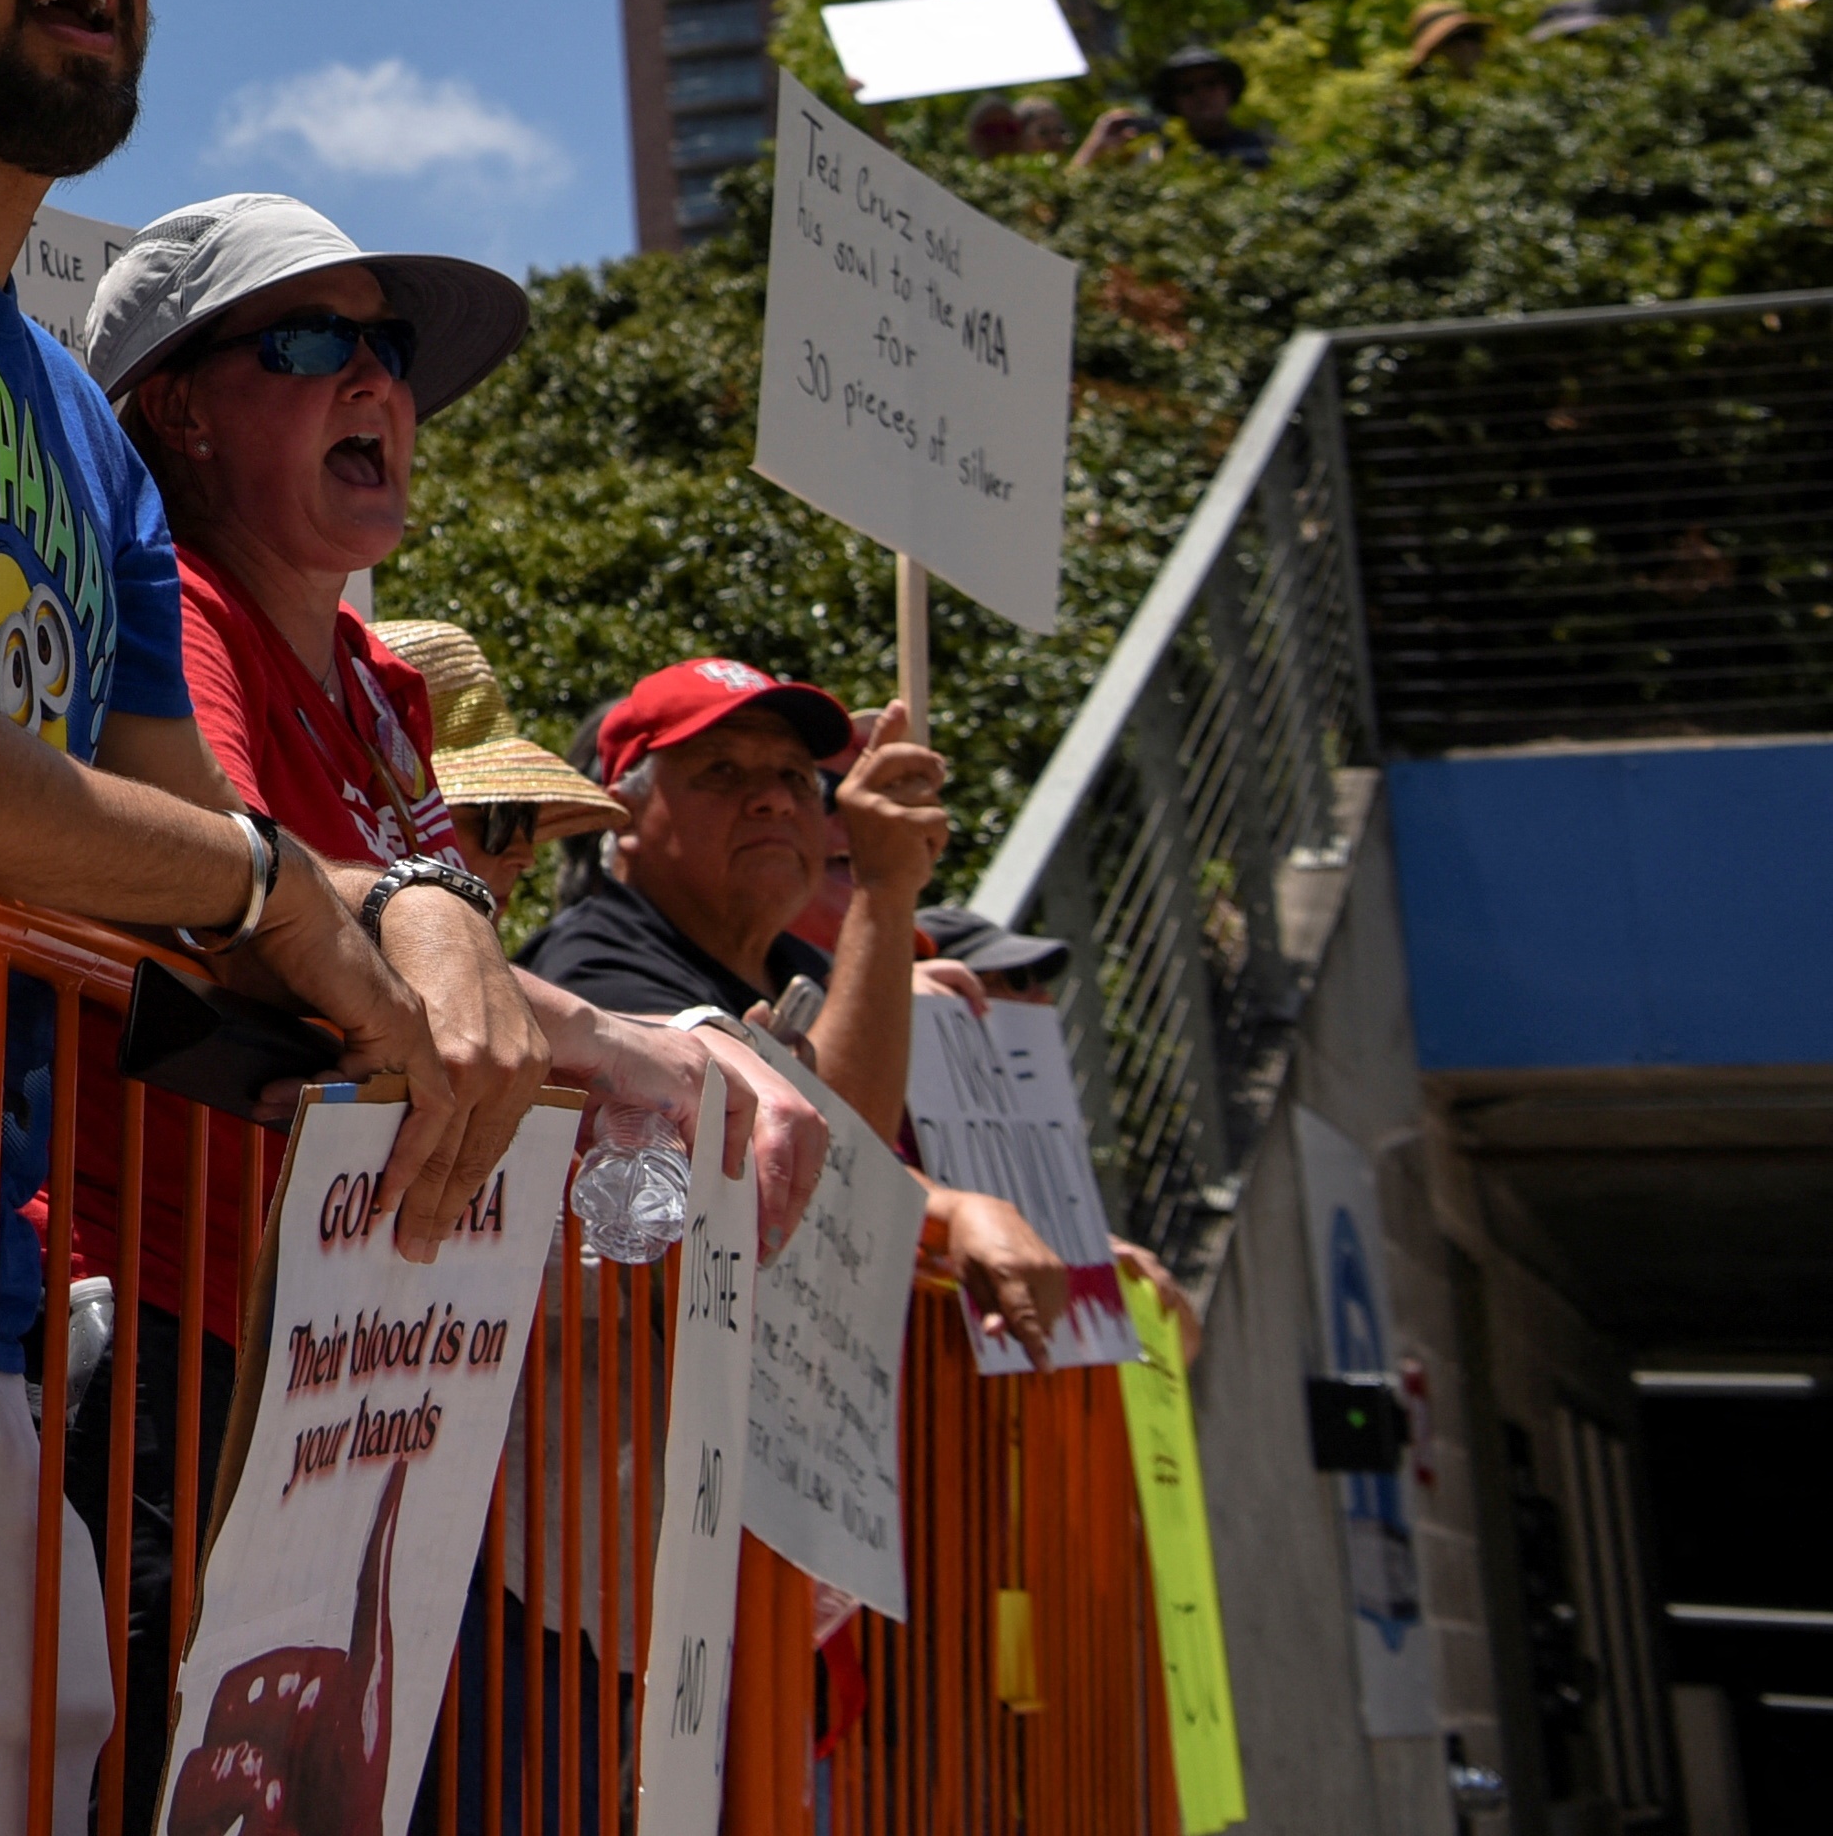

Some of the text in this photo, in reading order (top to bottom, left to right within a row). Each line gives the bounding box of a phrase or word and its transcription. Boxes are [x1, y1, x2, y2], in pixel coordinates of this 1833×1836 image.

[801, 109, 963, 278] Ted Cruz sold
[797, 182, 1009, 377] his soul to the NRA
[873, 316, 918, 370] for
[797, 338, 1015, 503] 30 pieces of silver
[455, 1169, 506, 1232] RA
[712, 1243, 740, 1333] THE
[287, 1302, 507, 1392] Their blood is on
[283, 1387, 442, 1496] your hands
[692, 1439, 723, 1538] AND
[671, 1634, 707, 1739] AND
